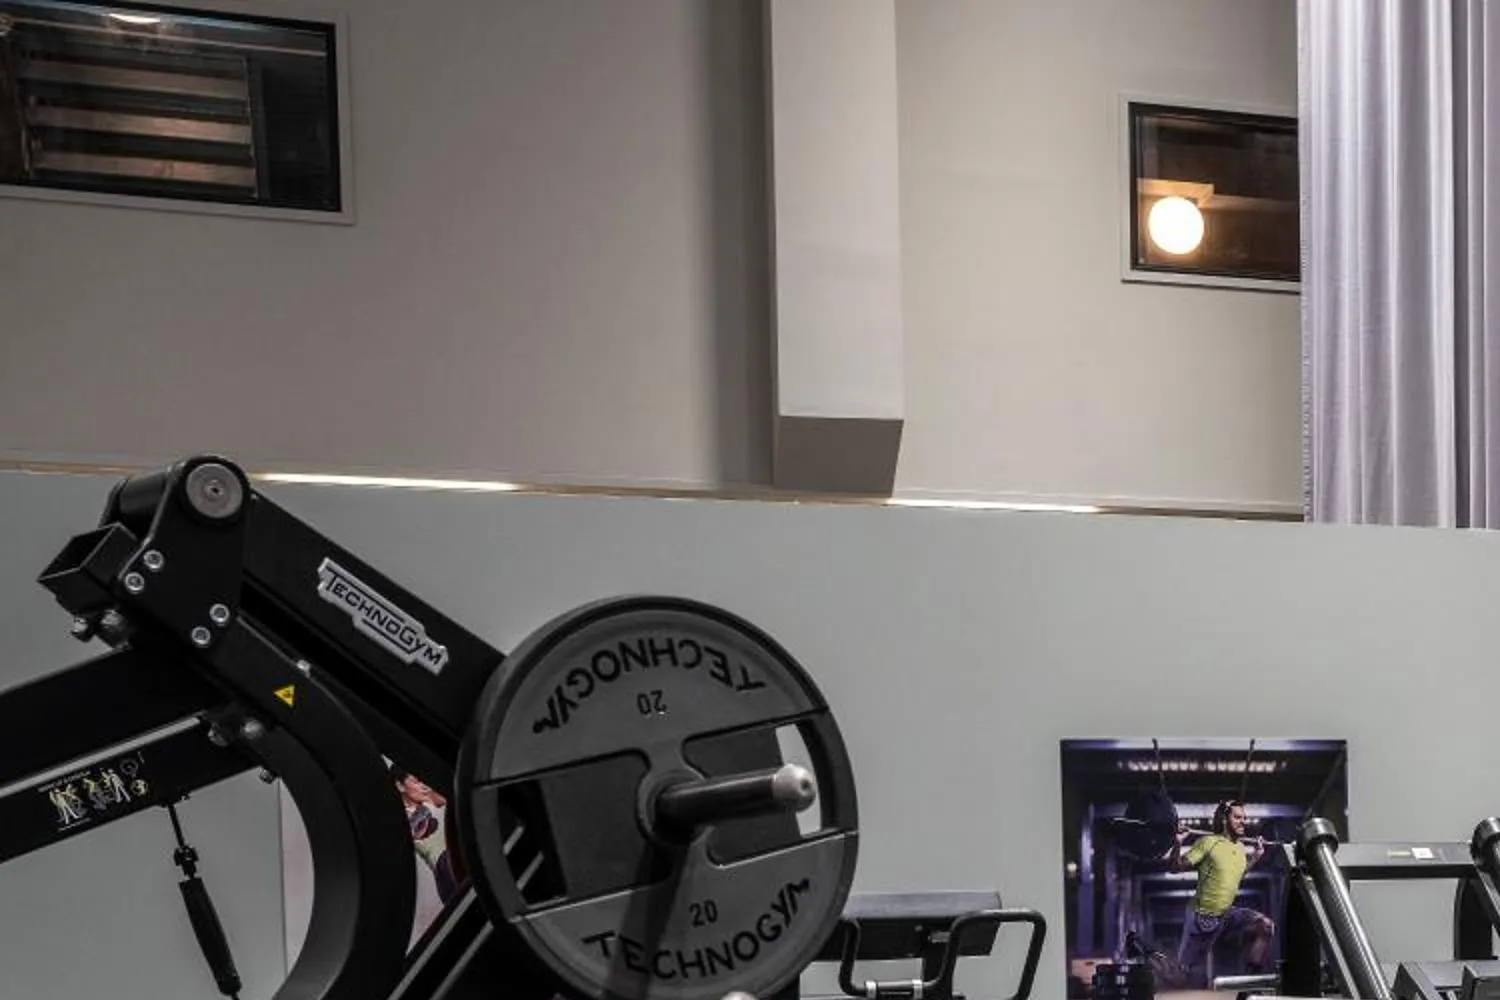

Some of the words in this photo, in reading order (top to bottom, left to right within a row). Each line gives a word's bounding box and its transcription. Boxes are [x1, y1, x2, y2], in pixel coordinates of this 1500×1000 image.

[325, 564, 442, 665] TECHNOGYM
[532, 638, 766, 734] TECHNOGYM
[636, 690, 667, 715] 20
[581, 878, 810, 979] TECHNOGYM
[689, 901, 718, 927] 20
